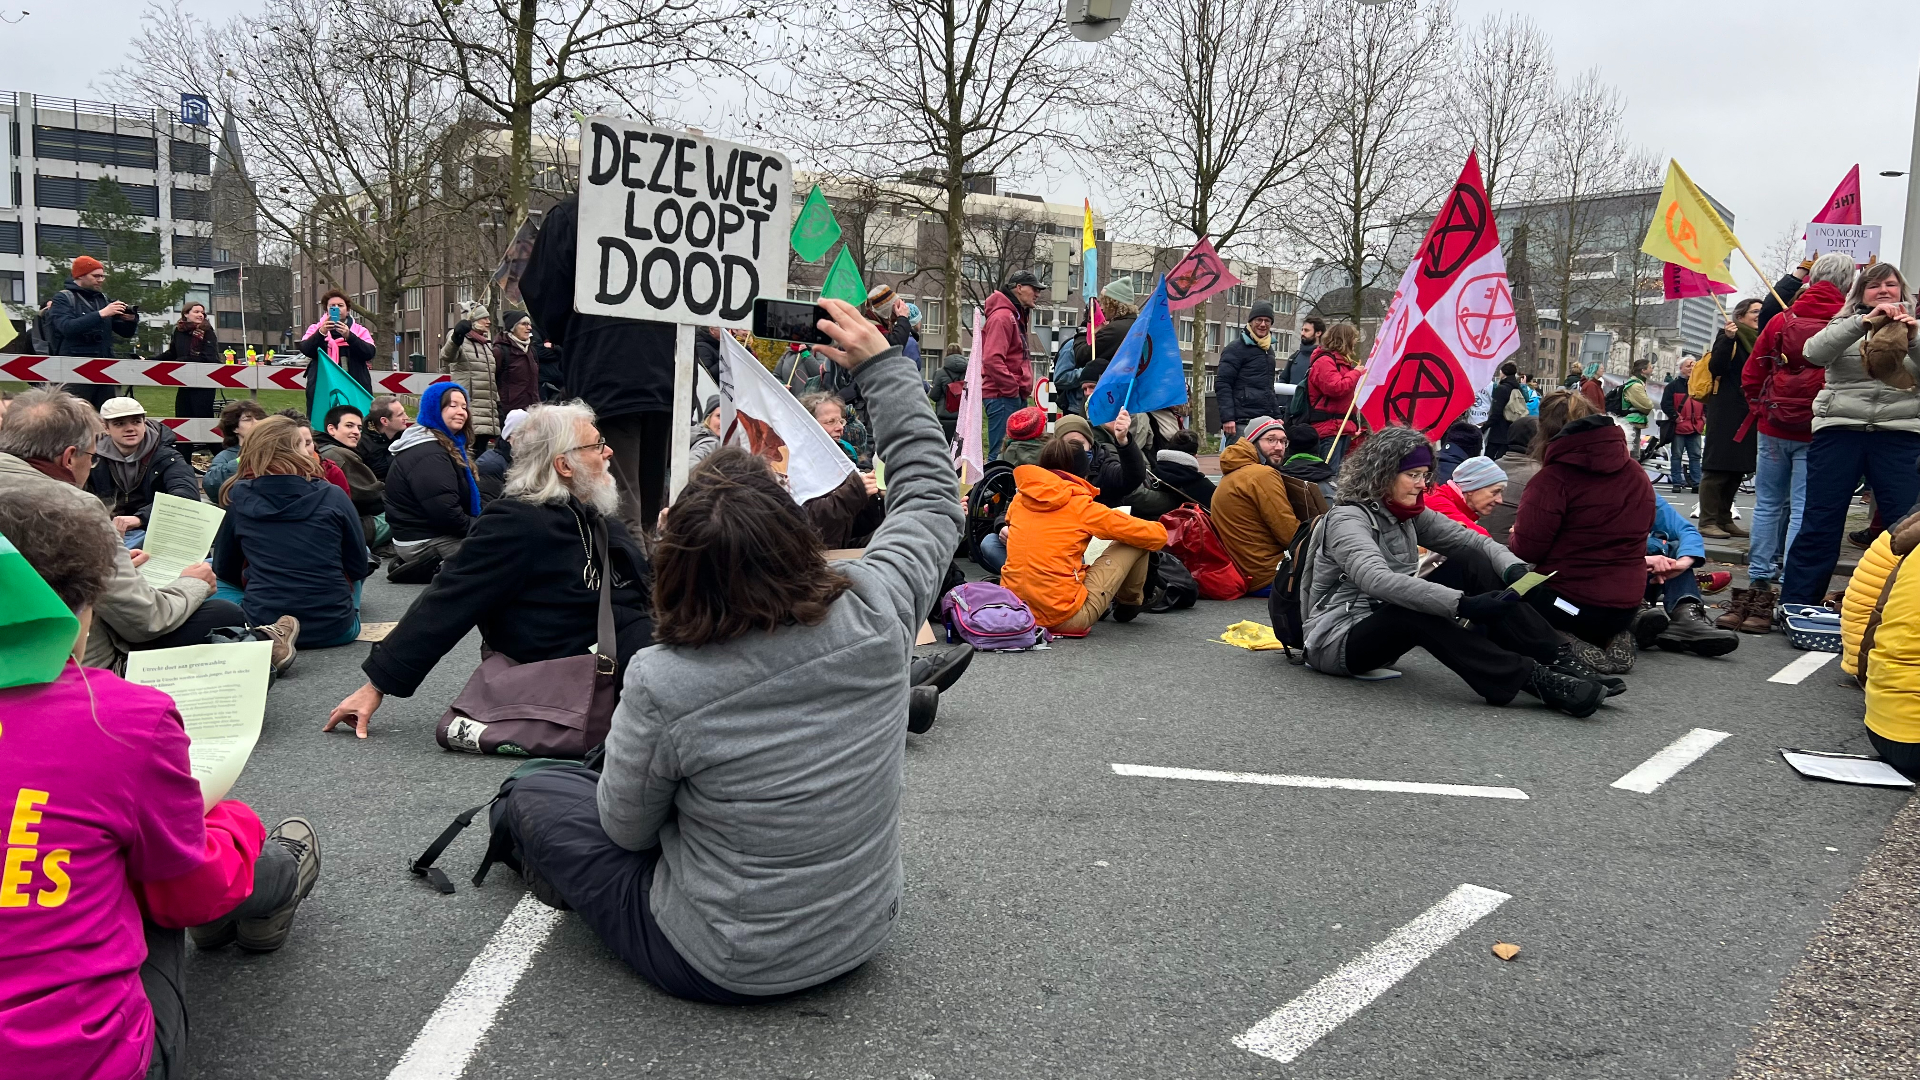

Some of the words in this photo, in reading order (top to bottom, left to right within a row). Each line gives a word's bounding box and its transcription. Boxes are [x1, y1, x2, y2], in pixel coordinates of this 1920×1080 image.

[588, 122, 697, 198] DEZE
[705, 144, 783, 212] WEG
[624, 190, 770, 260] LOOPT
[1820, 228, 1835, 237] NO
[1837, 229, 1868, 239] MORE
[1827, 239, 1859, 247] DIRTY
[595, 236, 760, 321] DOOD
